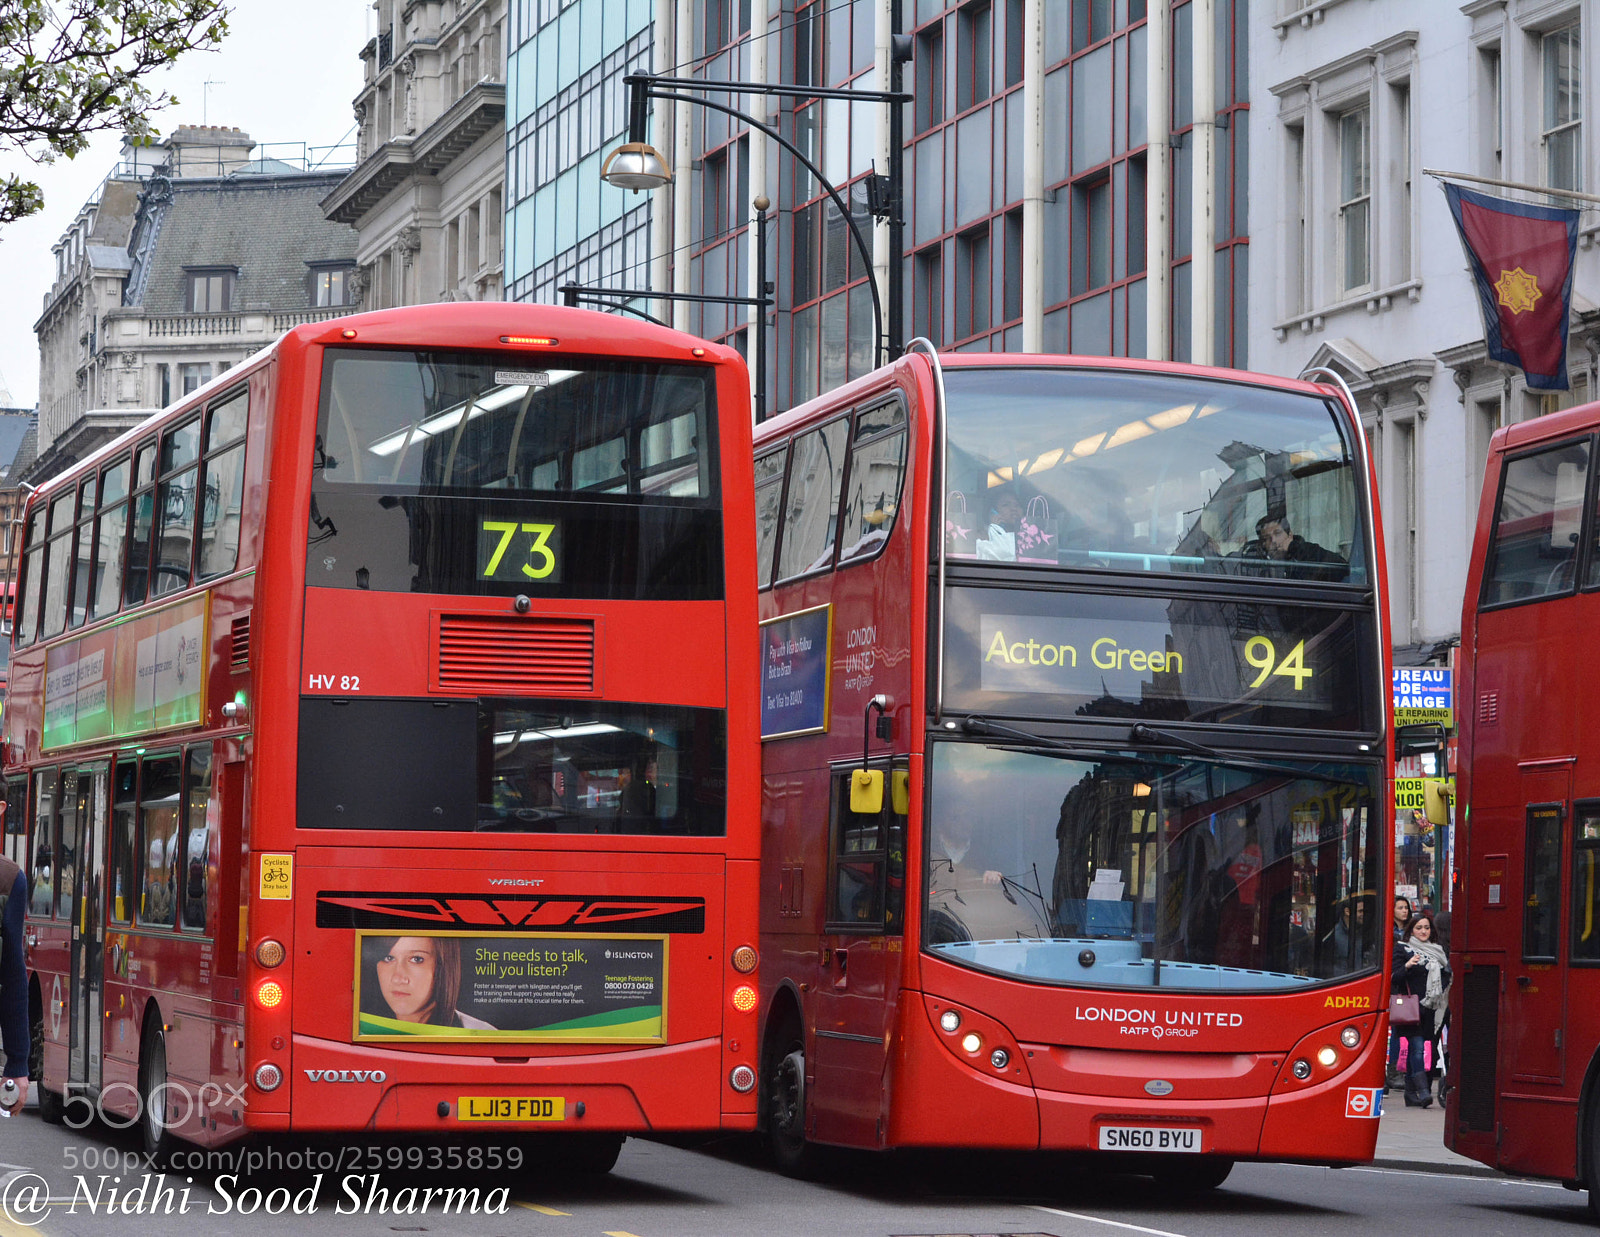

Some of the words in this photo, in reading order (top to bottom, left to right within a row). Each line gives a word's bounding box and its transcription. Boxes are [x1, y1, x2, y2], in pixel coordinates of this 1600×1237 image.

[496, 372, 533, 380] EMERGENCY
[482, 521, 556, 579] 73
[847, 626, 876, 648] LONDON
[984, 631, 1077, 667] Acton
[1091, 638, 1183, 673] Green
[846, 650, 874, 673] UNITED
[1244, 635, 1313, 690] 94
[309, 674, 336, 689] HV
[340, 675, 360, 690] 82
[1400, 683, 1421, 695] DE
[1393, 696, 1445, 708] HANGE
[1406, 710, 1448, 718] REPAIRING
[1397, 718, 1444, 726] UNLOCK
[476, 949, 499, 961] She
[503, 949, 541, 962] needs
[545, 950, 558, 962] to
[562, 949, 588, 964] talk,
[475, 963, 496, 976] will
[499, 966, 524, 979] you
[527, 964, 568, 976] listen?
[604, 982, 622, 990] 0800
[622, 982, 635, 990] 073
[1324, 996, 1370, 1008] ADH22
[1075, 1006, 1156, 1023] LONDON
[1166, 1011, 1243, 1026] UNITED
[1120, 1026, 1149, 1035] RATP
[1166, 1029, 1198, 1037] GROUP
[304, 1070, 386, 1083] VOLVO
[470, 1100, 511, 1117] LJ13
[517, 1100, 553, 1117] FDD
[1107, 1130, 1153, 1147] SN60
[1159, 1131, 1194, 1148] BYU
